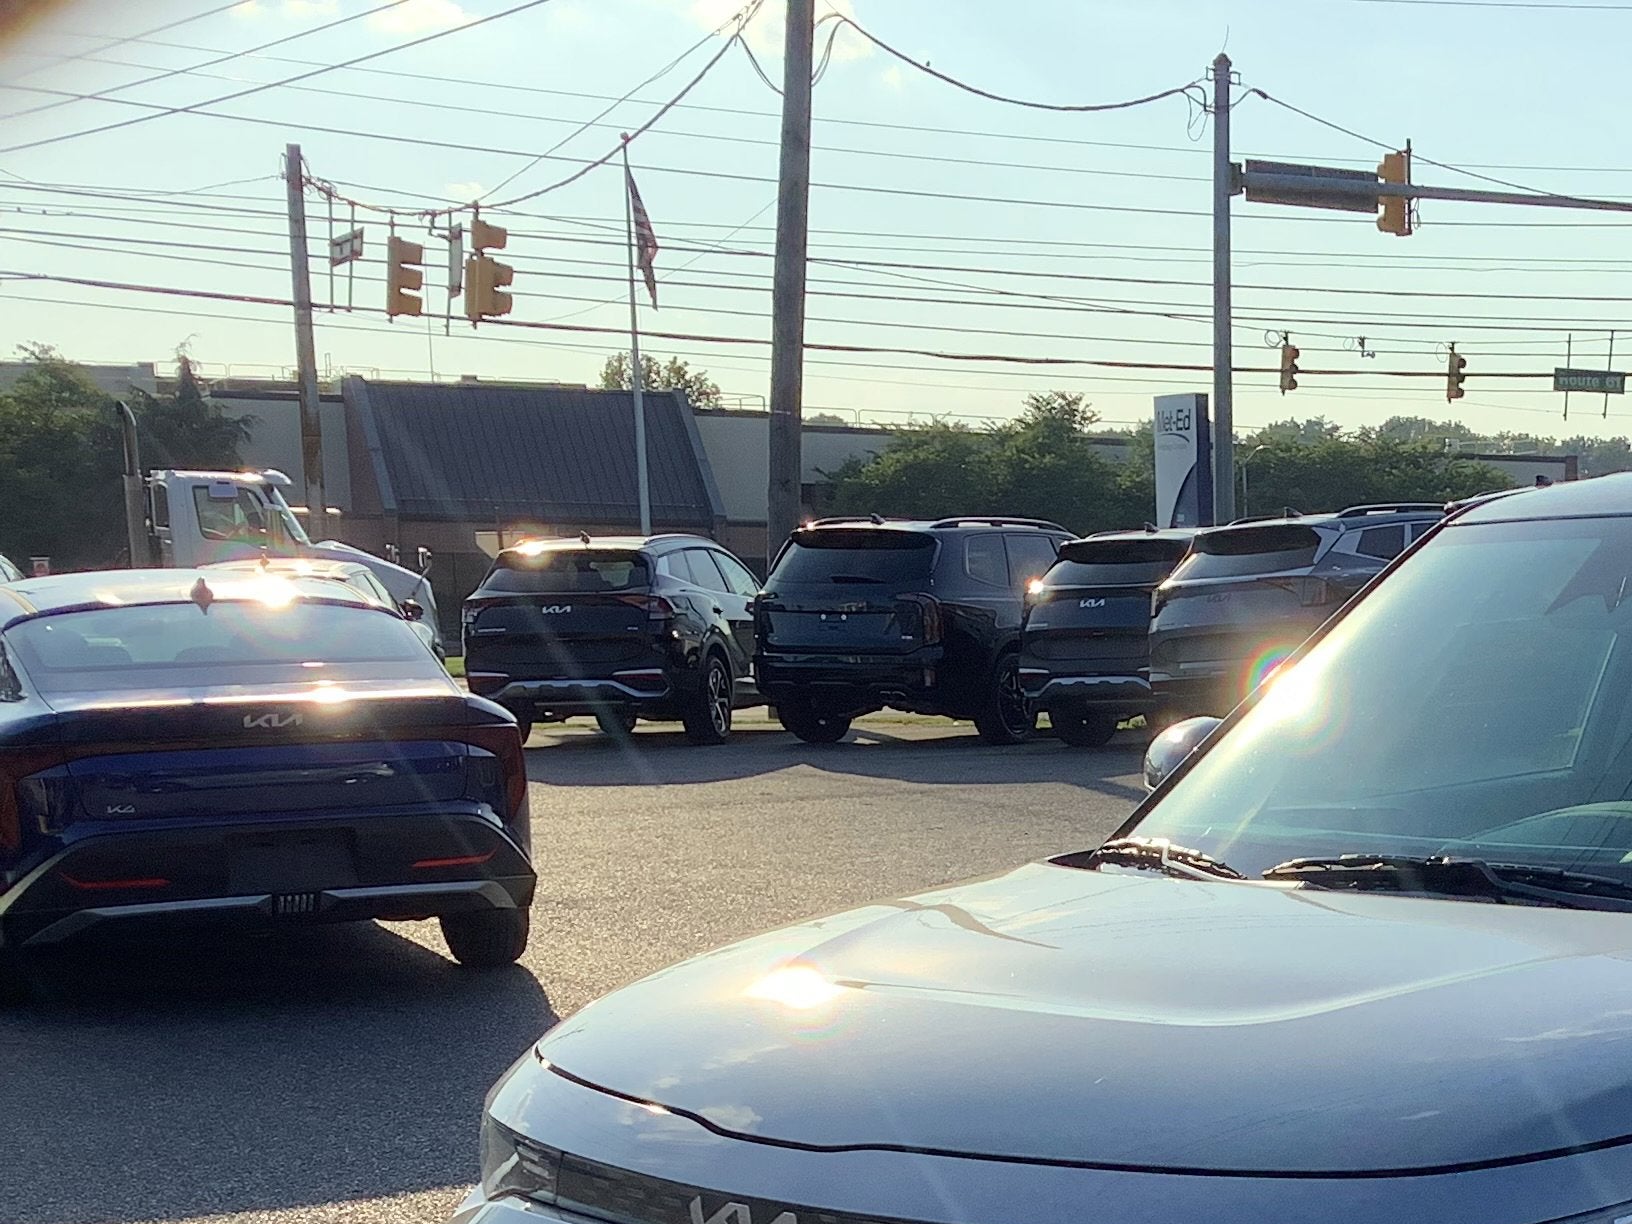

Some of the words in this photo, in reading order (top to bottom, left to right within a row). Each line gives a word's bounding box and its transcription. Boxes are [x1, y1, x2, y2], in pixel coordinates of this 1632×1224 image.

[1559, 374, 1600, 387] Route
[1605, 376, 1621, 389] 61
[1157, 408, 1192, 432] Met-Ed
[542, 605, 571, 614] KIA
[1079, 598, 1105, 608] KIA
[243, 713, 303, 729] KIA
